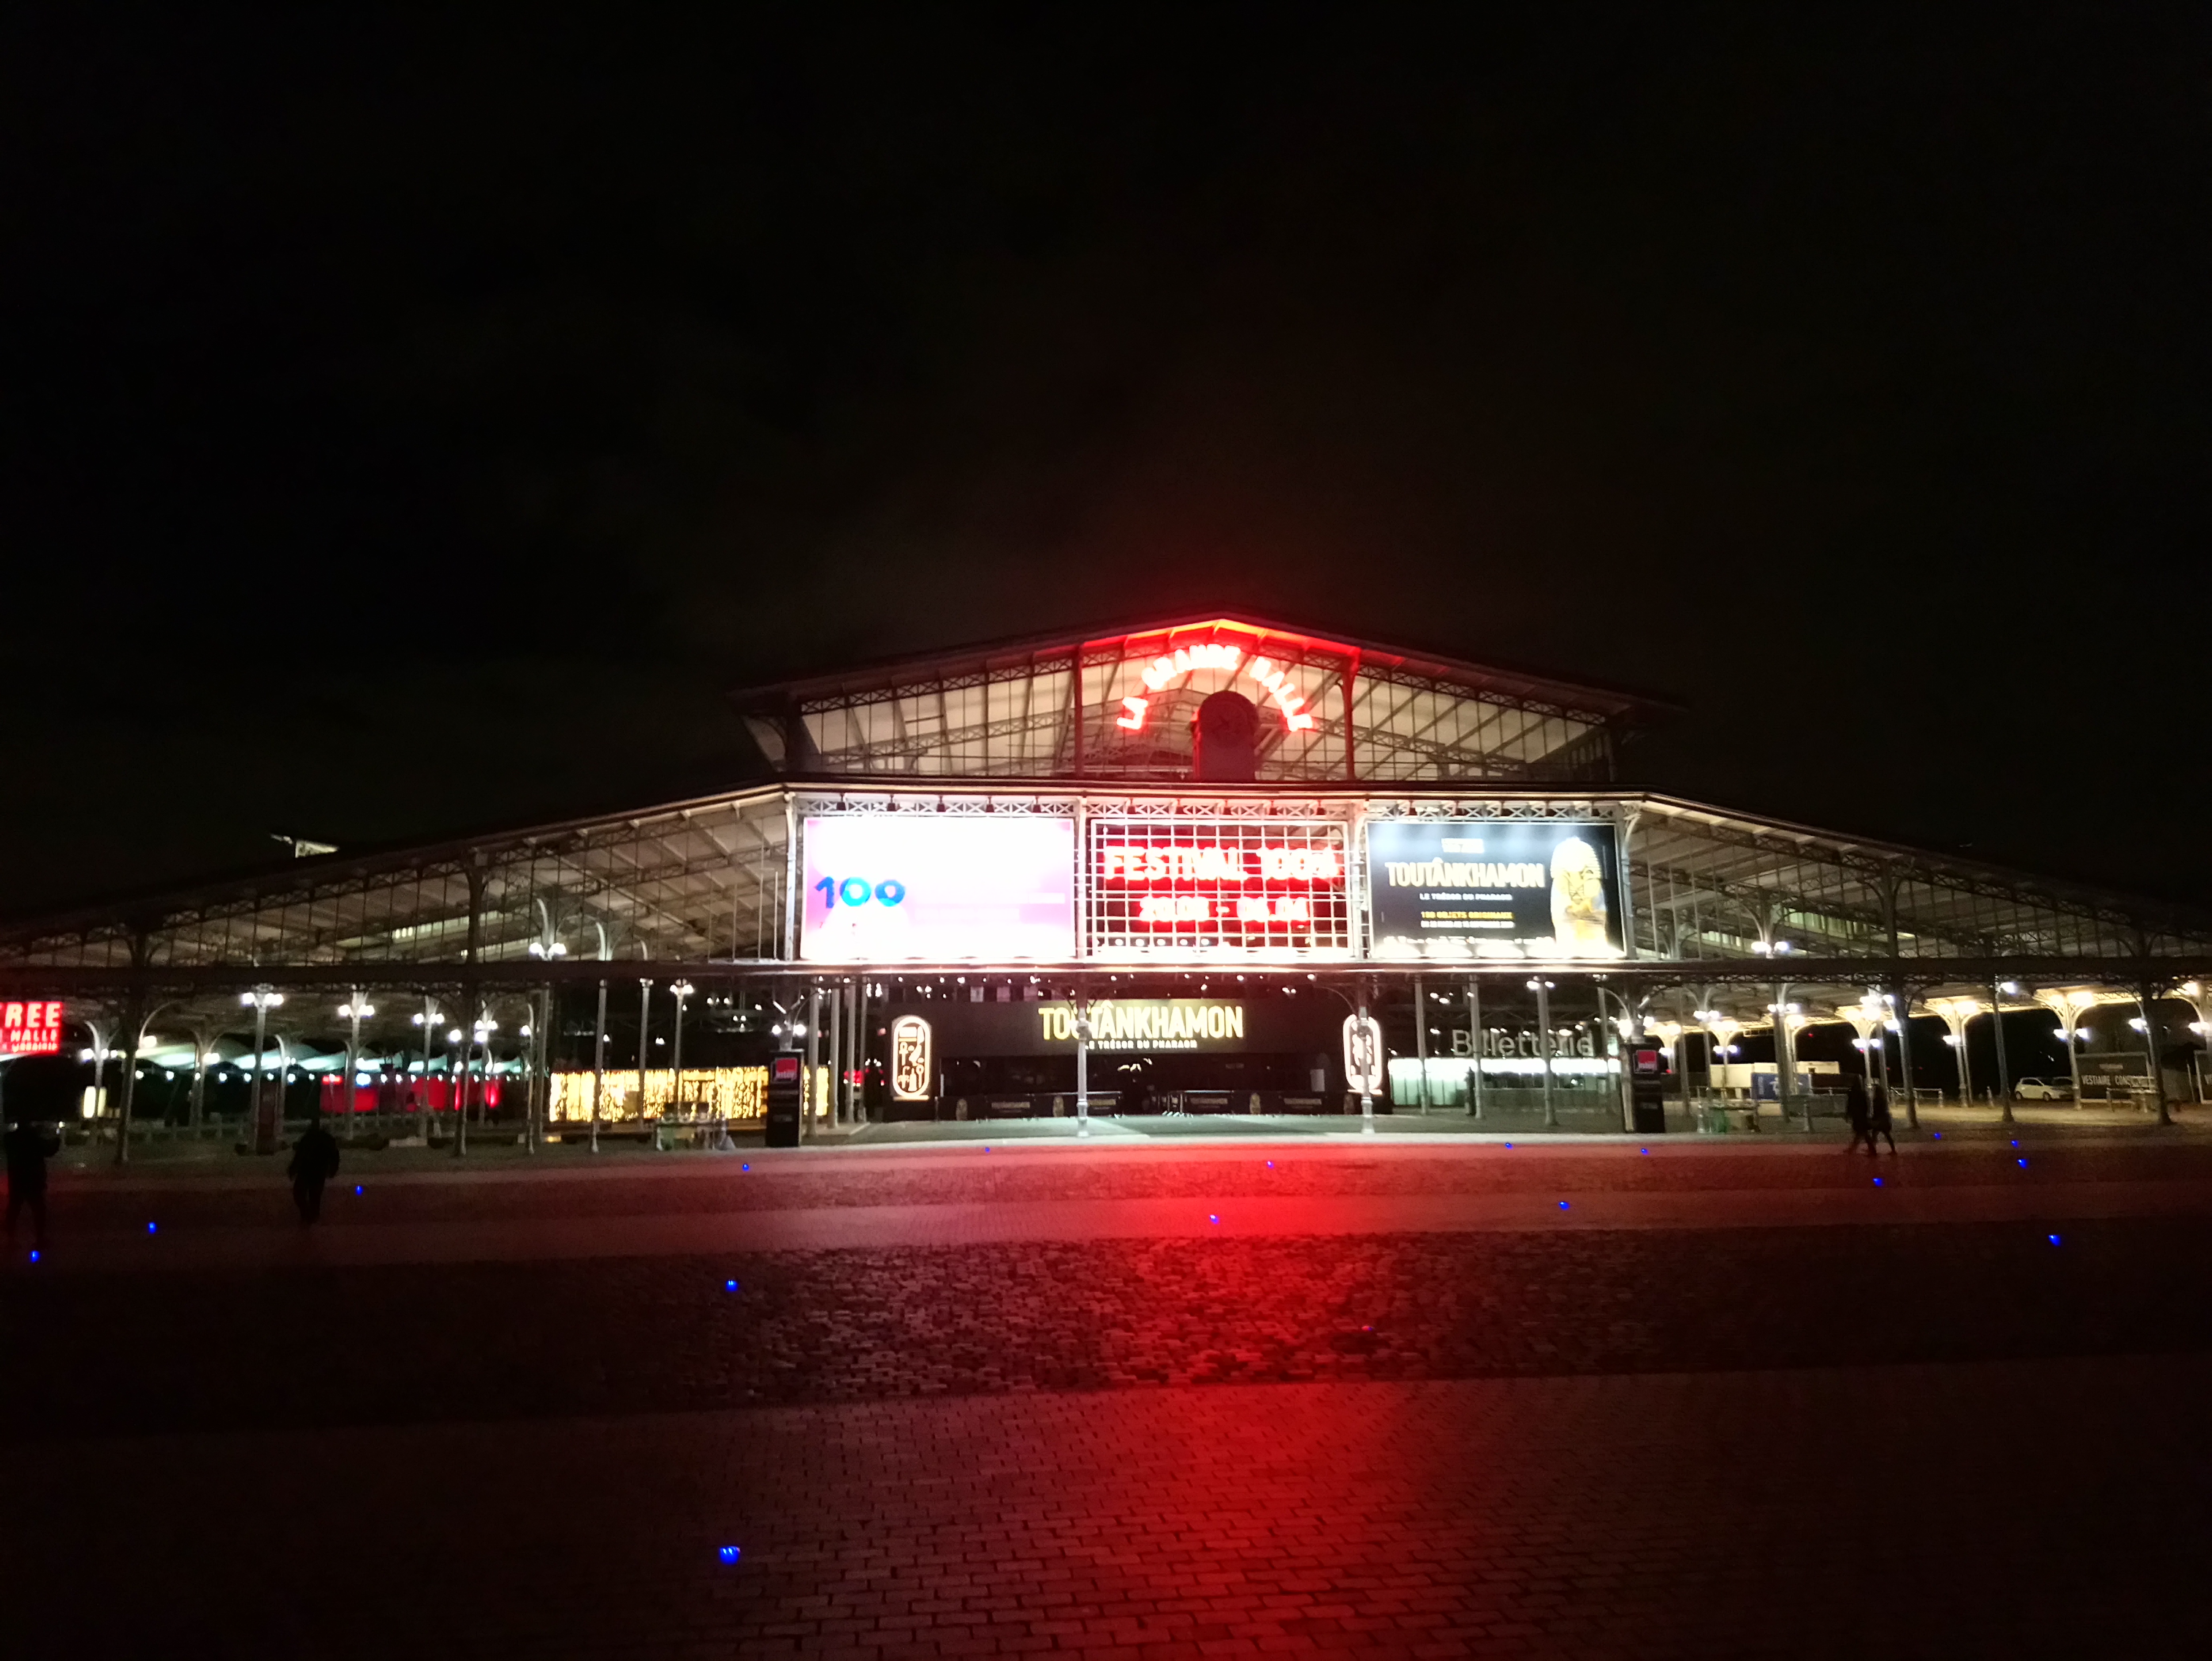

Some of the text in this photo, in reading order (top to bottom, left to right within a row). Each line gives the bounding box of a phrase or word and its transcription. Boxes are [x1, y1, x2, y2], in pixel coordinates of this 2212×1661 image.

[1117, 644, 1312, 731] LA GRANDE HALLE
[1104, 846, 1248, 881] FESTIVAL
[1385, 857, 1546, 887] TOUTÂNKHAMON
[0, 1003, 61, 1028] REE
[1452, 1029, 1596, 1057] Blletterie
